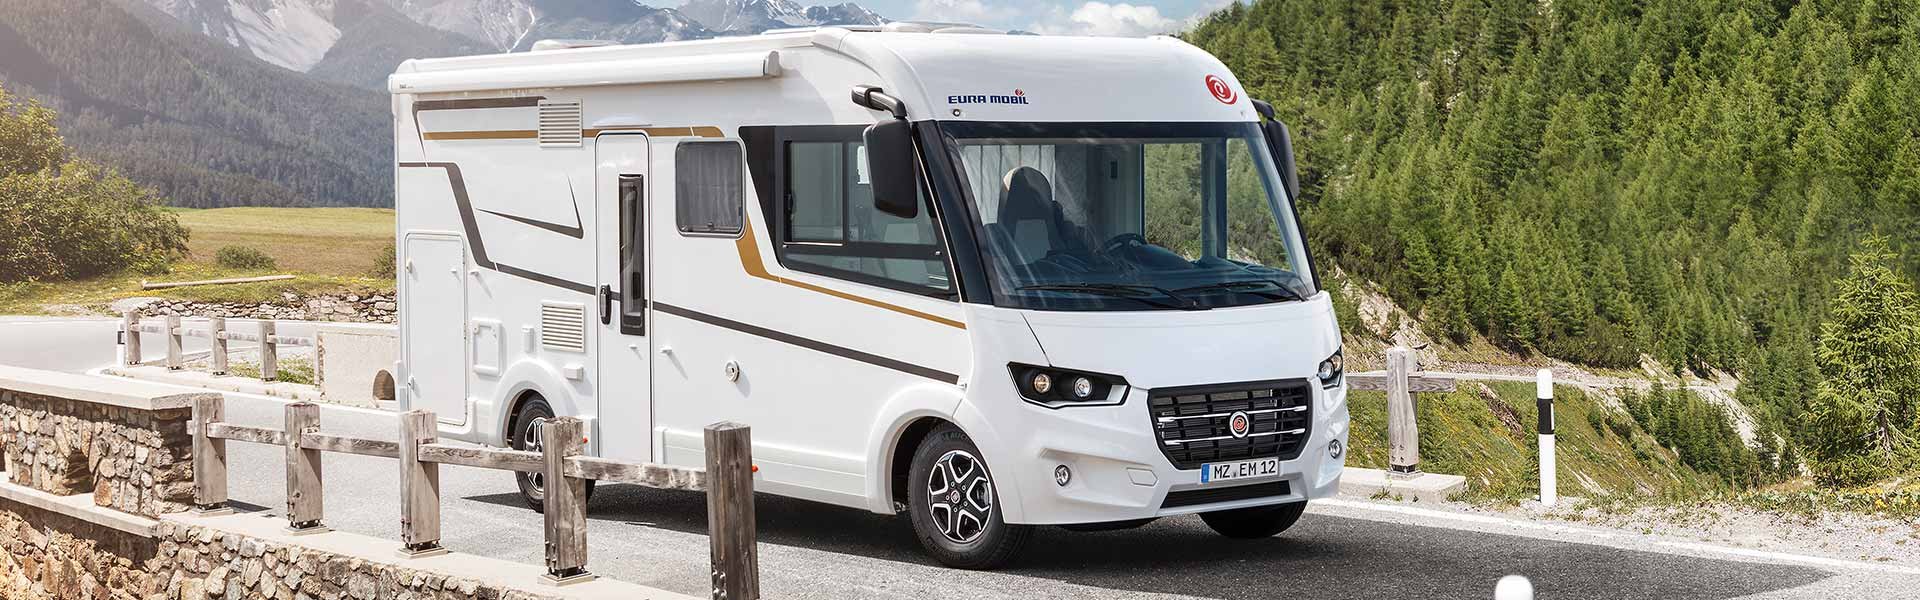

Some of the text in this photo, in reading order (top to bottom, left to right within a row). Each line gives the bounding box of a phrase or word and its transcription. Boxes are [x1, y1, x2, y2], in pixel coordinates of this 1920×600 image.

[947, 91, 1029, 105] EURA MOBIL
[1214, 460, 1276, 479] MZ EM 12
